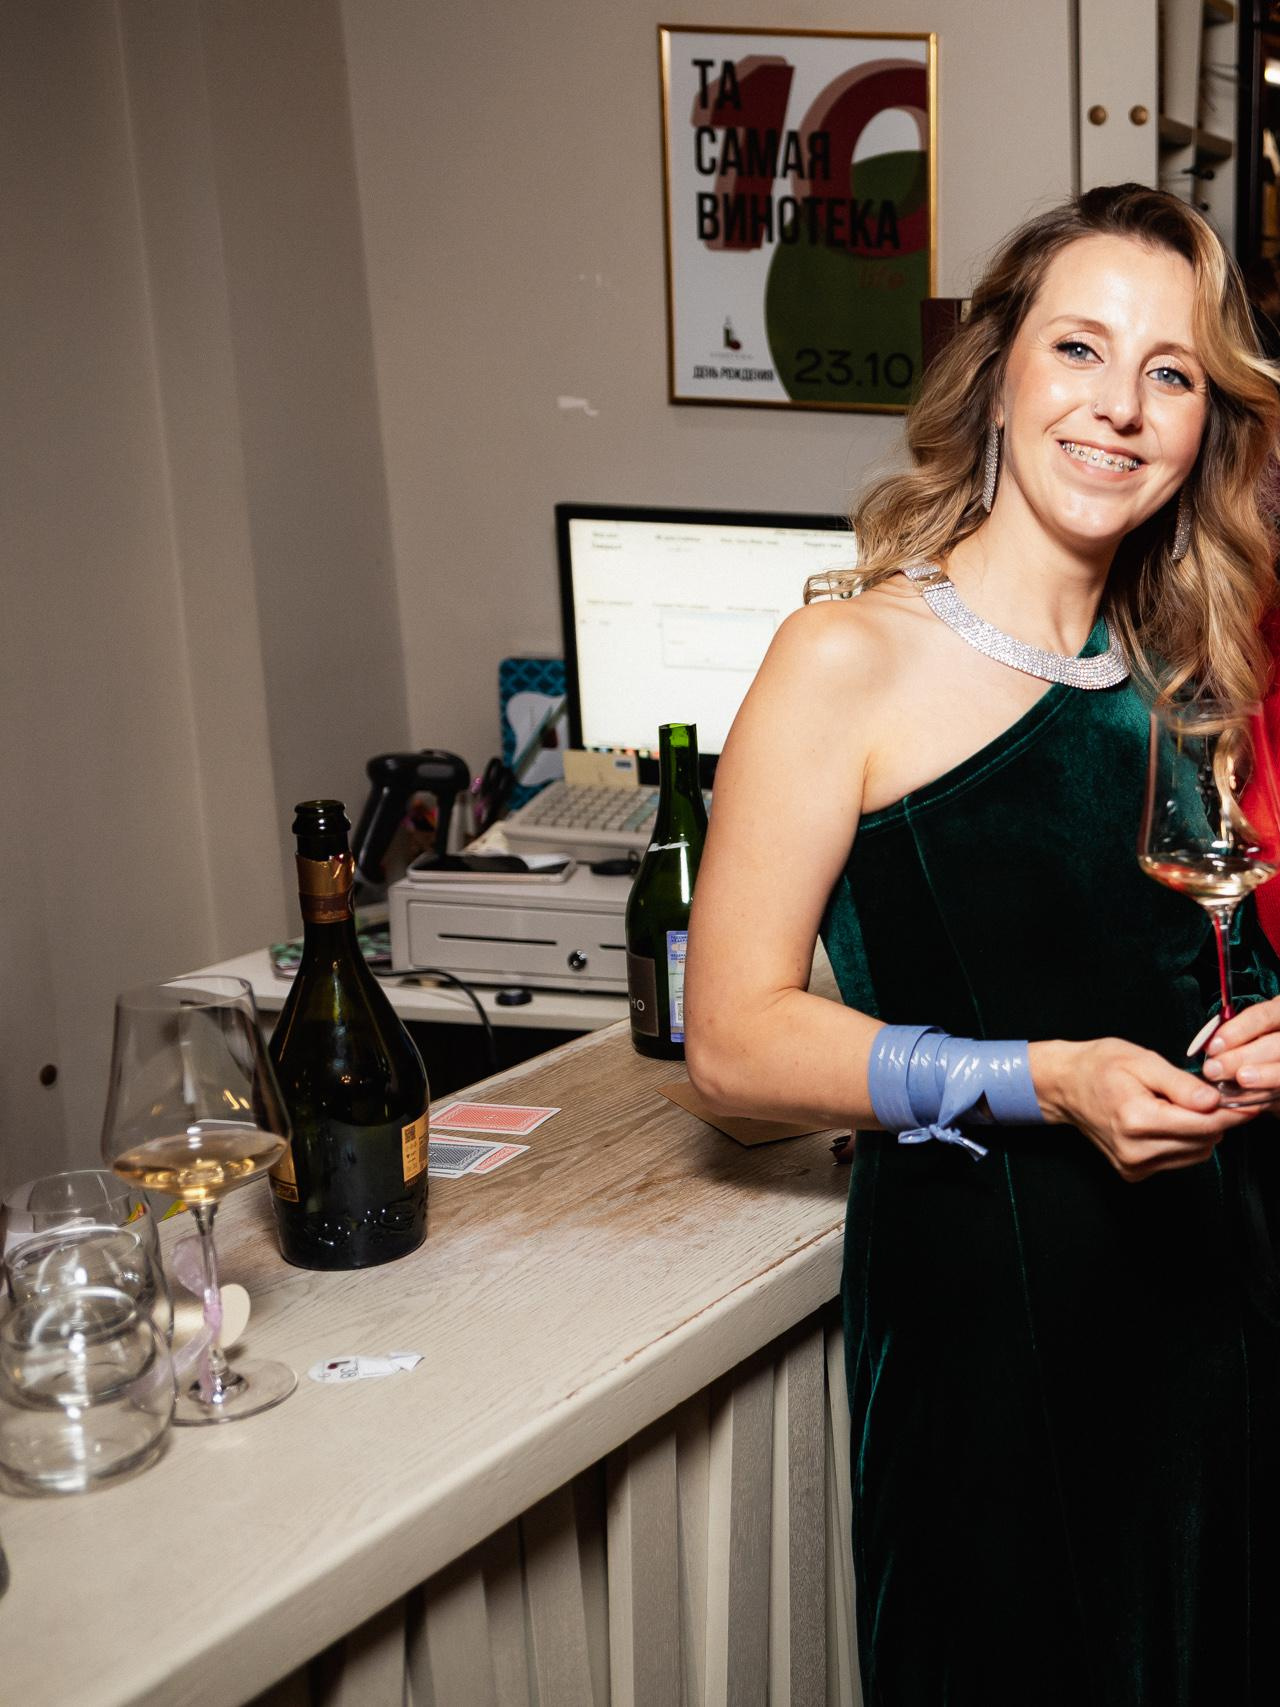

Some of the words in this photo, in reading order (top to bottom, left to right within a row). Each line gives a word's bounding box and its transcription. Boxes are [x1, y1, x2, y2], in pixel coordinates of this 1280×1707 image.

[692, 58, 741, 111] ТА
[693, 126, 831, 180] САМАЯ
[696, 192, 900, 249] ВИНОТЕКА
[693, 365, 720, 380] ДЕНЬ
[721, 367, 774, 381] РОЖДЕНИЯ
[794, 348, 913, 389] 23.10
